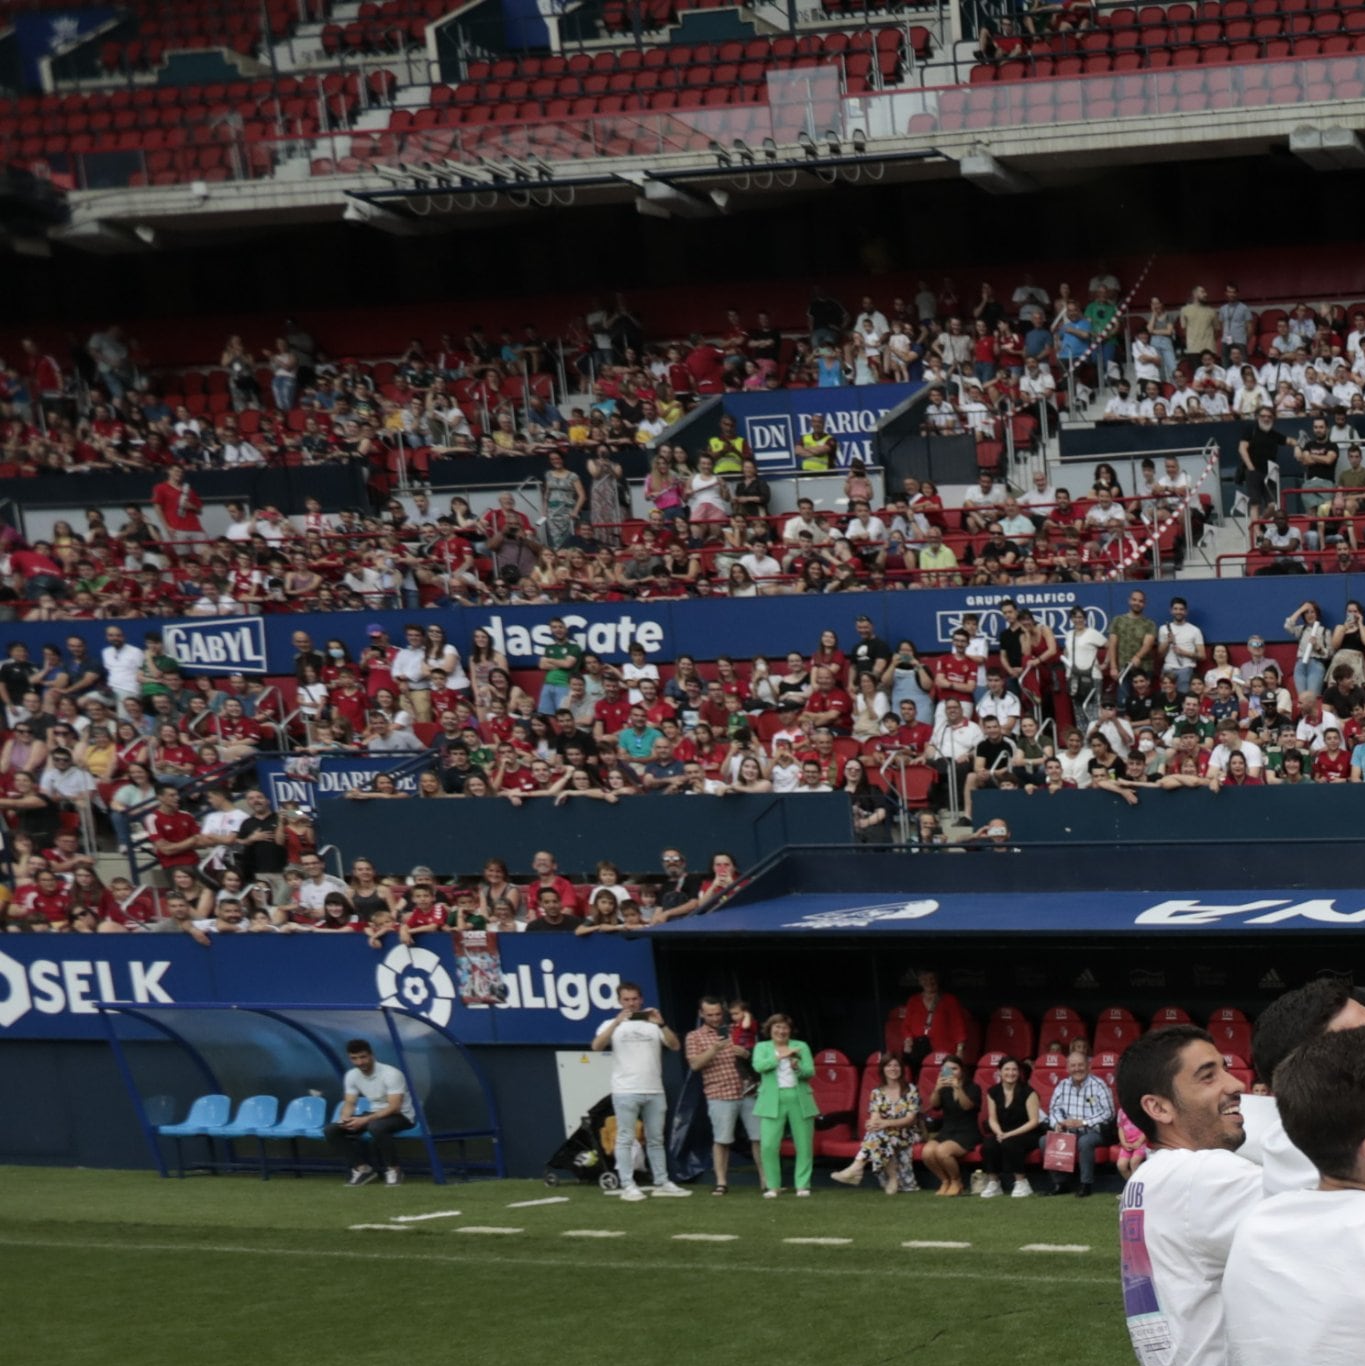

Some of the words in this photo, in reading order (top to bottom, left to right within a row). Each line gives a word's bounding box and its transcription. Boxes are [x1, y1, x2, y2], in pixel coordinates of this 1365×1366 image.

[752, 423, 787, 450] DN
[966, 594, 1012, 606] GRUP
[1016, 591, 1076, 604] GRAFICO
[276, 781, 307, 802] DN
[32, 960, 175, 1014] SELK
